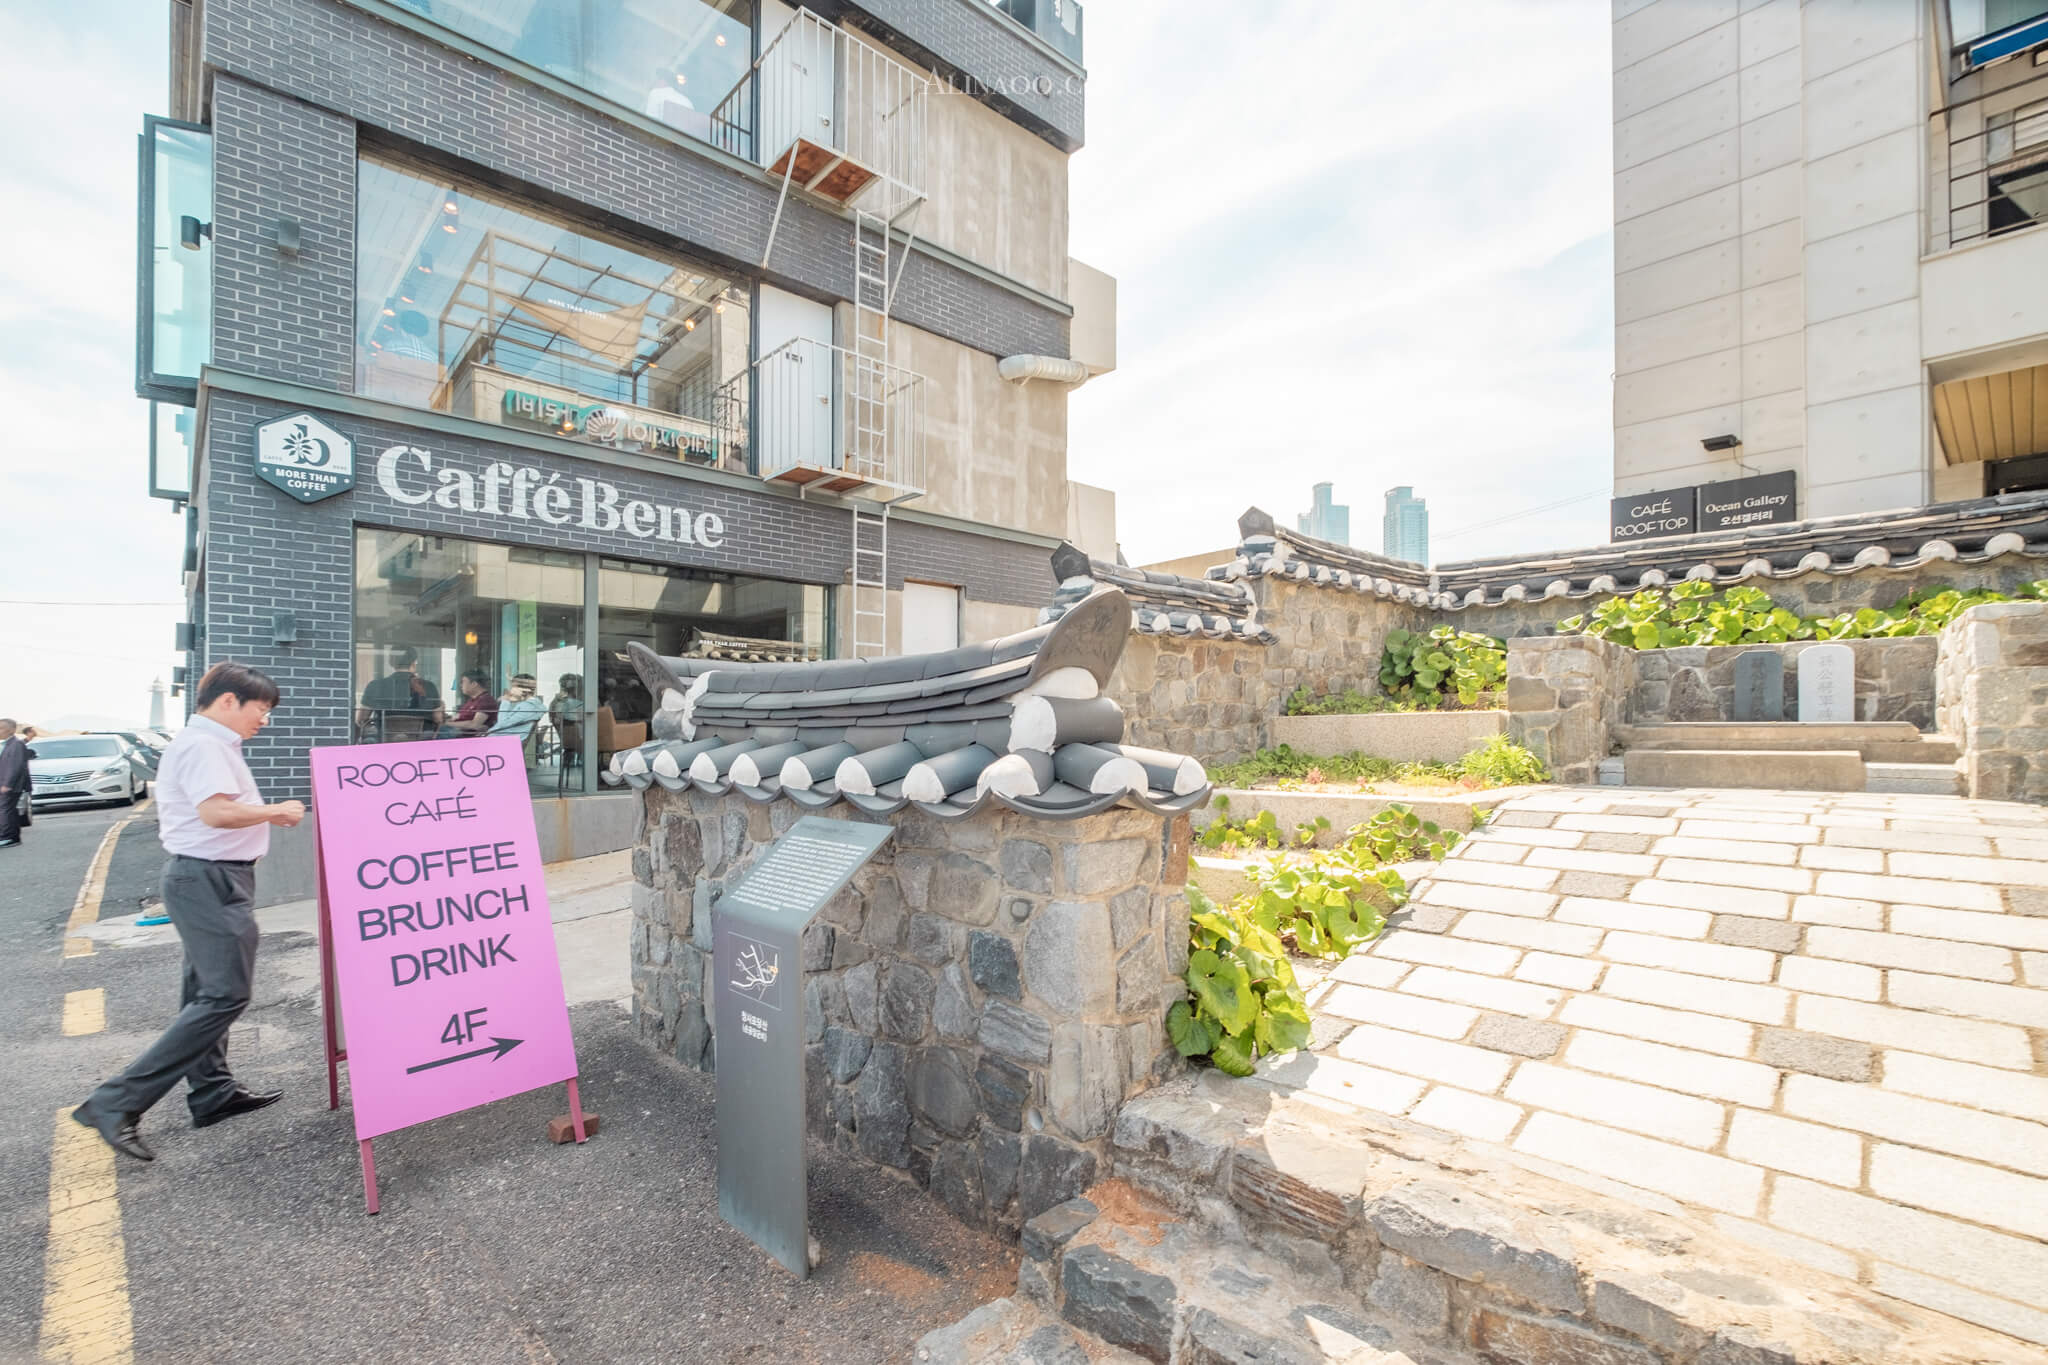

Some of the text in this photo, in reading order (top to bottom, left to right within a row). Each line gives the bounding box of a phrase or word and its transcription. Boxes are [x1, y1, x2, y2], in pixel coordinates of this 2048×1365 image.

[275, 468, 337, 484] MORE THAN
[287, 479, 327, 492] COFFEE
[1631, 498, 1673, 518] CAFÉ
[1705, 494, 1788, 513] Ocean Gallery
[1614, 516, 1689, 537] ROOFTOP
[1720, 510, 1773, 527] 오션갤러리
[337, 754, 505, 789] ROOFTOP
[385, 786, 478, 826] CAFÉ
[357, 841, 519, 890] COFFEE
[357, 884, 530, 941] BRUNCH
[390, 933, 518, 987] DRINK
[440, 1007, 489, 1046] 4F
